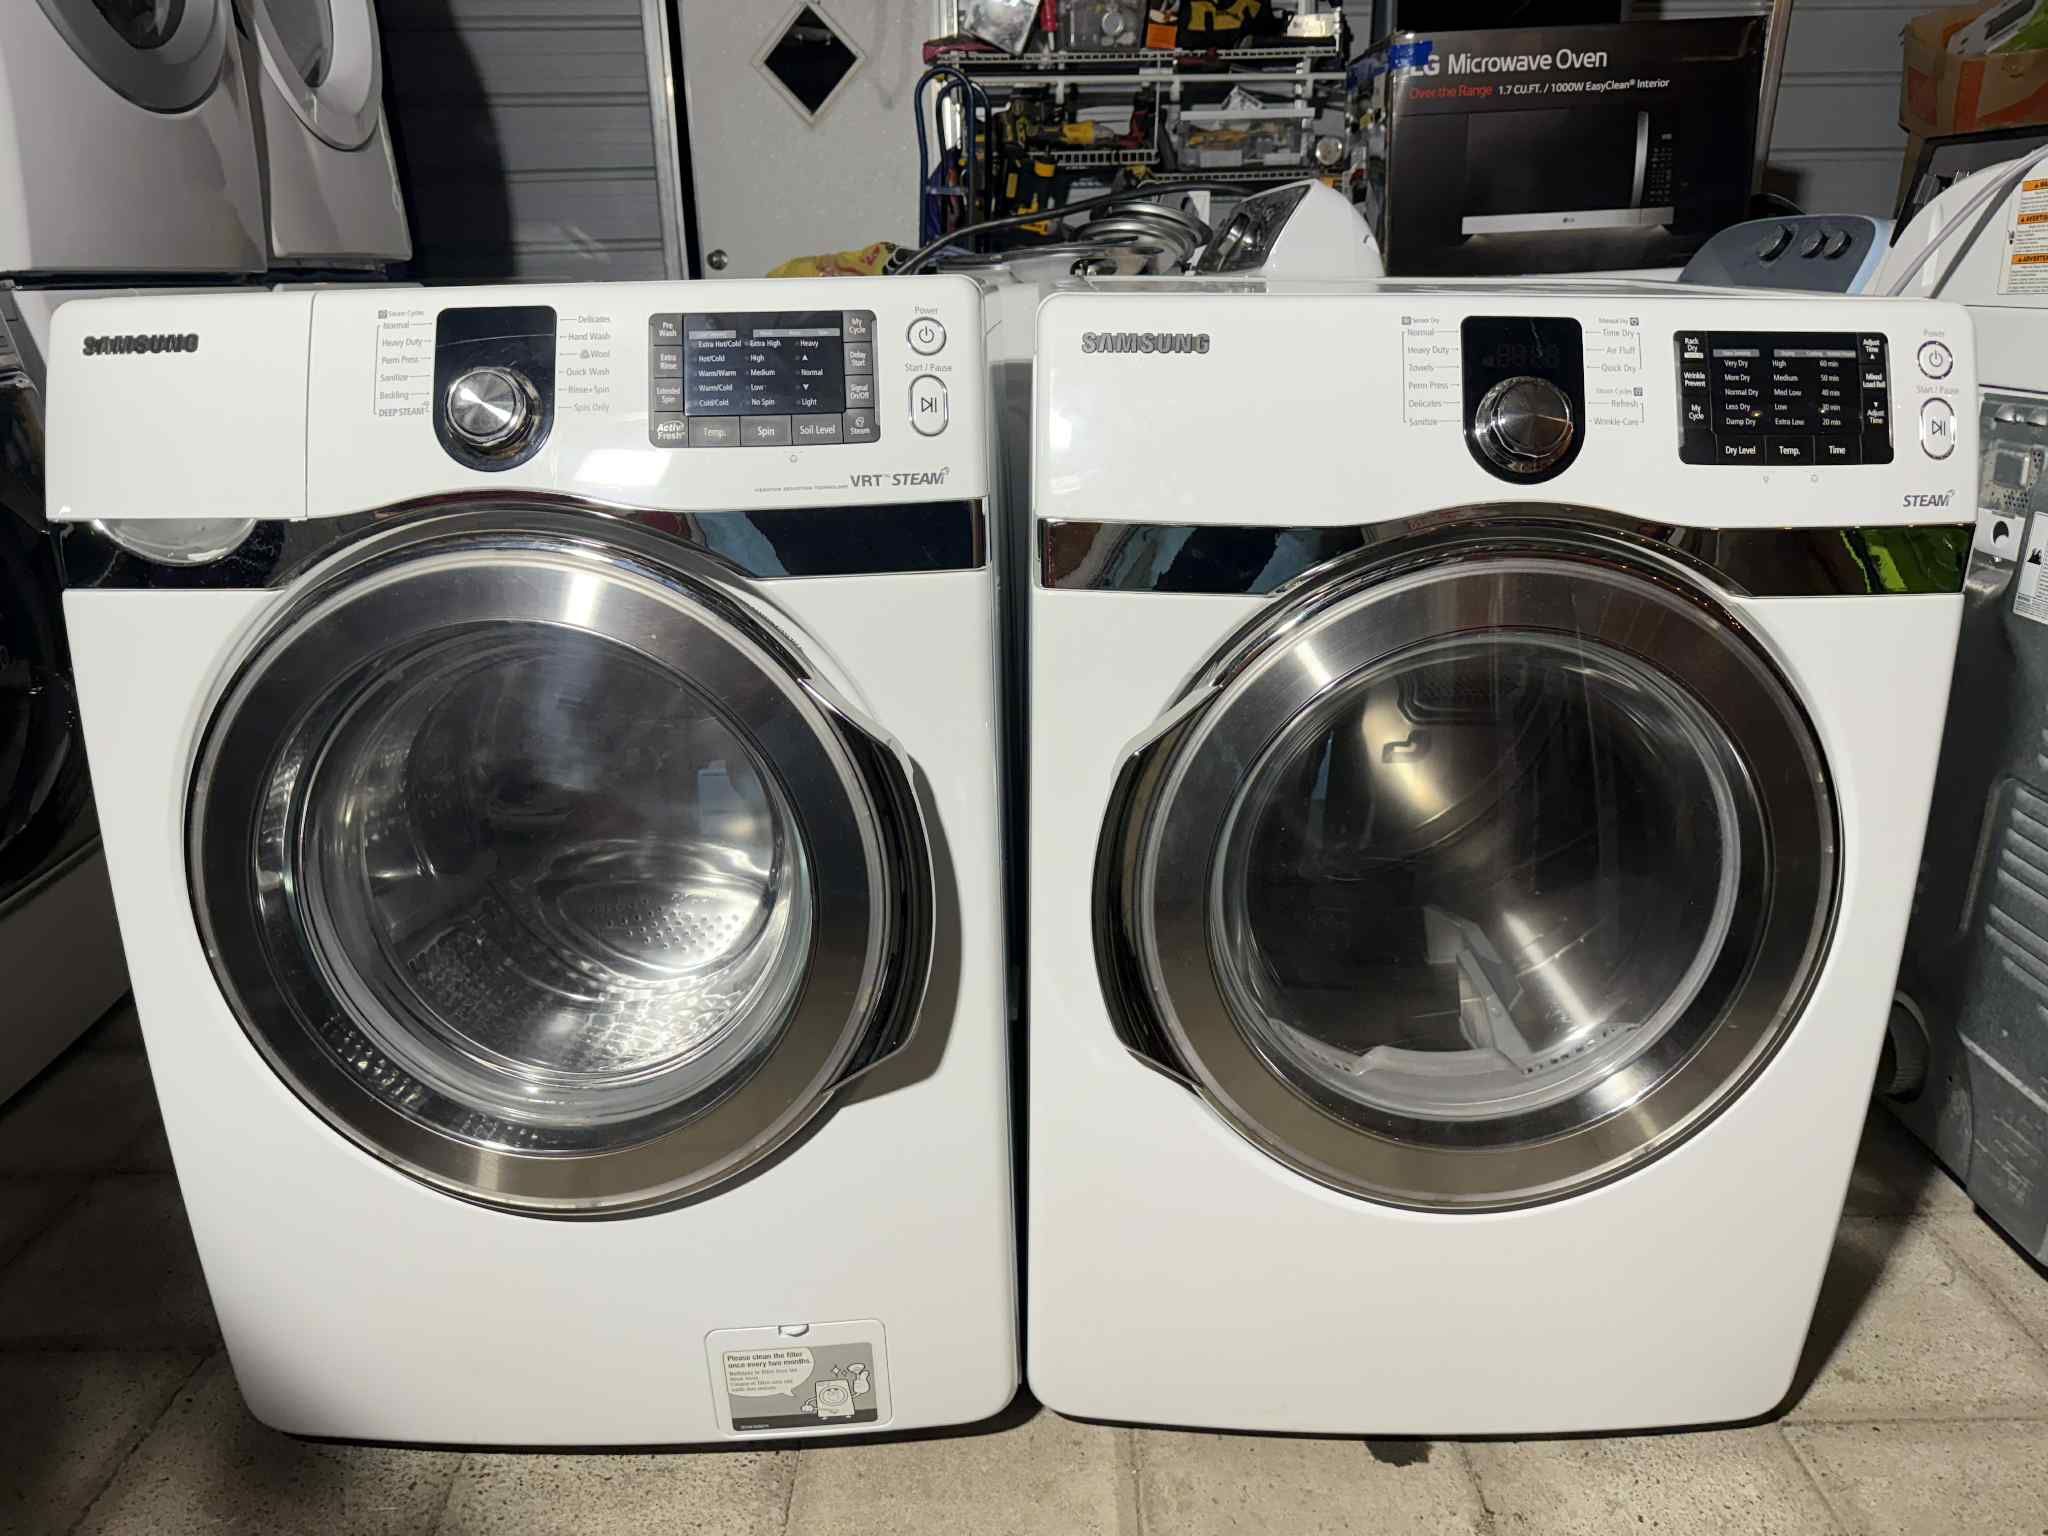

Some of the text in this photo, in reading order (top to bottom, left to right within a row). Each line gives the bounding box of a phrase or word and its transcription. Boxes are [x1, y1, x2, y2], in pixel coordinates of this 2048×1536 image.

[1448, 53, 1552, 74] Microwave
[1556, 48, 1608, 69] Oven
[1408, 88, 1434, 98] Over
[1438, 86, 1456, 97] the
[1458, 84, 1492, 98] Range
[1499, 86, 1511, 94] 1.7
[1551, 82, 1584, 93] 1000W
[1637, 78, 1670, 88] Interior
[914, 306, 938, 314] Power
[578, 314, 610, 323] Delicates
[852, 318, 862, 327] My
[662, 322, 673, 330] Pre
[849, 326, 866, 336] Cycle
[1408, 328, 1434, 336] Normal
[1602, 328, 1634, 338] Time Dry
[568, 332, 610, 340] Hand Wash
[83, 334, 198, 356] SAMSUNG
[382, 337, 423, 348] Heavy Duty
[698, 340, 742, 348] Extra Hot/Cold
[766, 340, 781, 348] High
[800, 340, 818, 348] Heavy
[1082, 332, 1210, 354] SAMSUNG
[1408, 345, 1448, 355] Heavy Duty
[1606, 346, 1635, 354] Air Fluff
[1687, 344, 1698, 352] Dry
[590, 350, 610, 358] Wool
[660, 354, 676, 362] Extra
[698, 354, 725, 362] Hot/Cold
[850, 352, 866, 360] Delay
[382, 356, 418, 364] Perm Press
[750, 354, 764, 363] High
[905, 363, 922, 372] Start
[930, 363, 952, 372] Pause
[1408, 364, 1434, 372] Towels
[1724, 360, 1748, 368] Very Dry
[1772, 360, 1786, 368] High
[1820, 360, 1839, 368] 60 min
[566, 368, 610, 376] Quick Wash
[801, 368, 824, 376] Normal
[1601, 364, 1636, 374] Quick Dry
[380, 373, 408, 382] Sanitize
[1740, 374, 1750, 382] Dry
[1774, 374, 1798, 382] Medium
[1820, 374, 1828, 382] 50
[698, 384, 732, 392] Warm/Cold
[851, 384, 868, 392] Signal
[1408, 381, 1448, 390] Perm Press
[1684, 380, 1706, 388] Prevent
[1725, 388, 1758, 398] Normal Dry
[1774, 388, 1788, 396] Med
[1916, 386, 1932, 394] Start
[1940, 386, 1959, 394] Pause
[380, 390, 409, 400] Bedding
[850, 392, 869, 400] On/Off
[699, 398, 728, 406] Cold/Cold
[752, 398, 774, 406] No Spin
[802, 398, 816, 408] Light
[1408, 400, 1442, 408] Delicates
[1611, 400, 1638, 408] Refresh
[574, 402, 610, 412] Spin Only
[1691, 404, 1701, 412] My
[1740, 403, 1750, 412] Dry
[1688, 412, 1704, 421] Cycle
[1870, 416, 1883, 424] Time
[1592, 416, 1639, 426] Wrinkle Care
[1726, 418, 1756, 427] Damp Dry
[1775, 418, 1805, 426] Extra Low
[1822, 418, 1830, 426] 20
[758, 426, 774, 438] Spin
[800, 424, 836, 434] Soil Level
[1726, 446, 1756, 456] Dry Level
[1779, 446, 1800, 456] Temp.
[1828, 445, 1846, 454] Time
[892, 472, 944, 486] STEAM
[1903, 494, 1950, 508] STEAM
